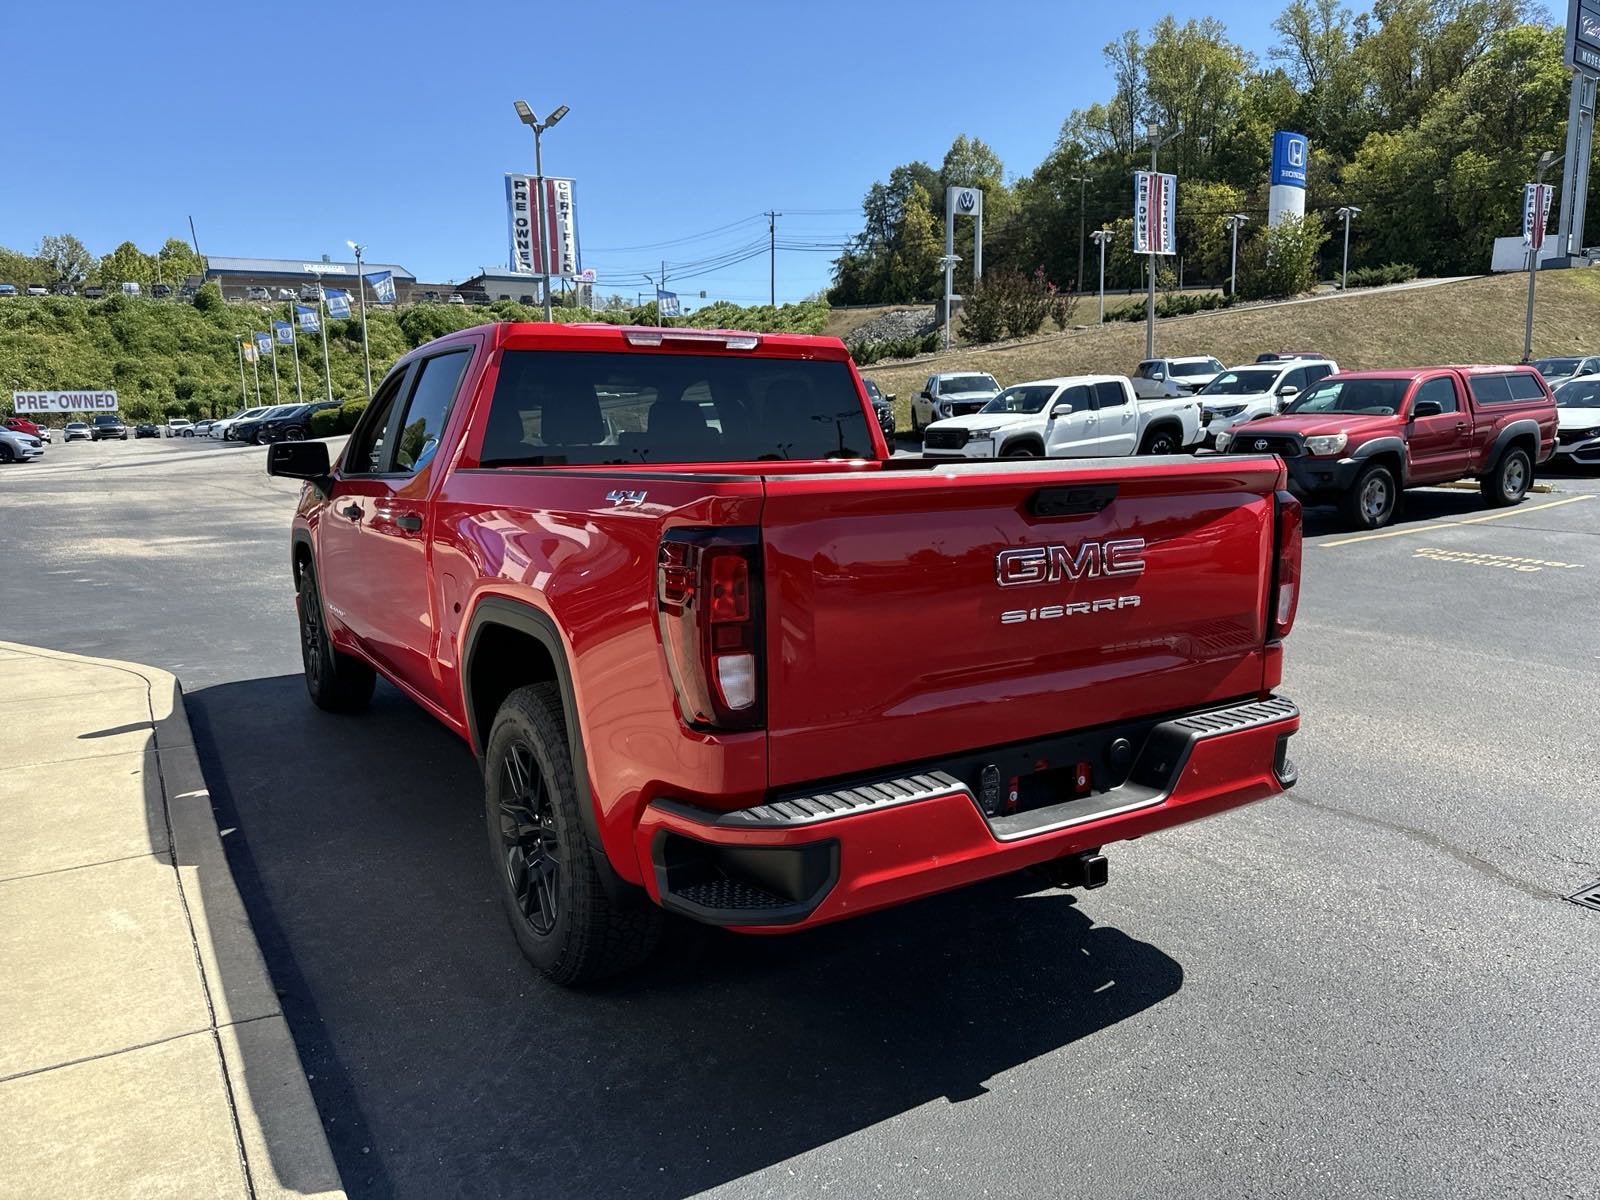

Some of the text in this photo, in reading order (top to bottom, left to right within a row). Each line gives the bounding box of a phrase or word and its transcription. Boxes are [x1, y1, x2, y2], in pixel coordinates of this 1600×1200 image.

[514, 180, 527, 212] PRE
[1140, 176, 1148, 202] PRE
[16, 394, 115, 410] PRE-OWNED
[994, 538, 1145, 588] GMC
[1001, 595, 1141, 624] SIERRA
